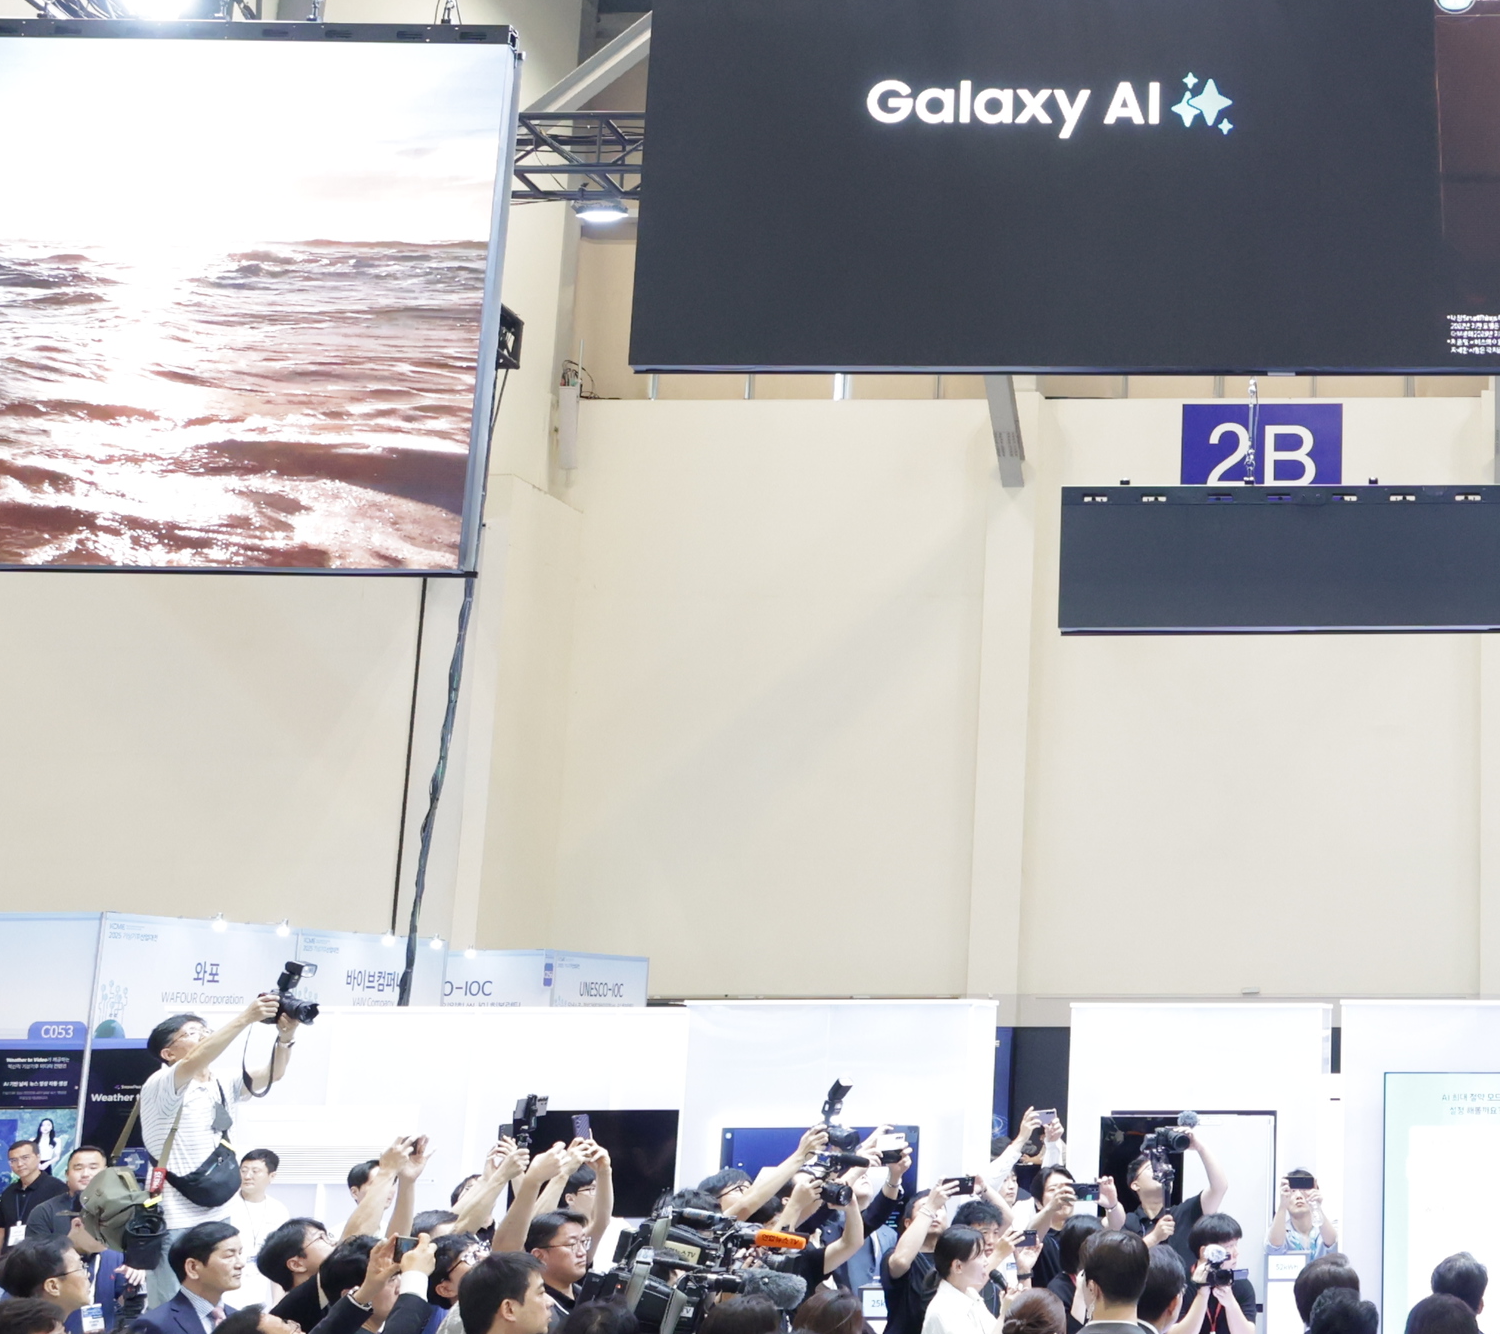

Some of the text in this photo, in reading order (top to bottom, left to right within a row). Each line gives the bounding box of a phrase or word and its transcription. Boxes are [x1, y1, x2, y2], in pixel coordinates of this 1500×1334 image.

[866, 79, 1161, 139] Galaxy AI
[1206, 422, 1316, 485] 2B
[193, 961, 220, 984] 와포
[444, 980, 493, 997] O-IOC
[579, 981, 624, 998] UNESCO-IOC
[161, 991, 244, 1008] WAFOUR Corporation
[41, 1024, 74, 1038] C053
[91, 1093, 133, 1103] Weather
[1452, 1093, 1468, 1102] 최대
[1469, 1093, 1485, 1102] 절약
[1450, 1106, 1465, 1115] 설정
[871, 1299, 886, 1308] 25k
